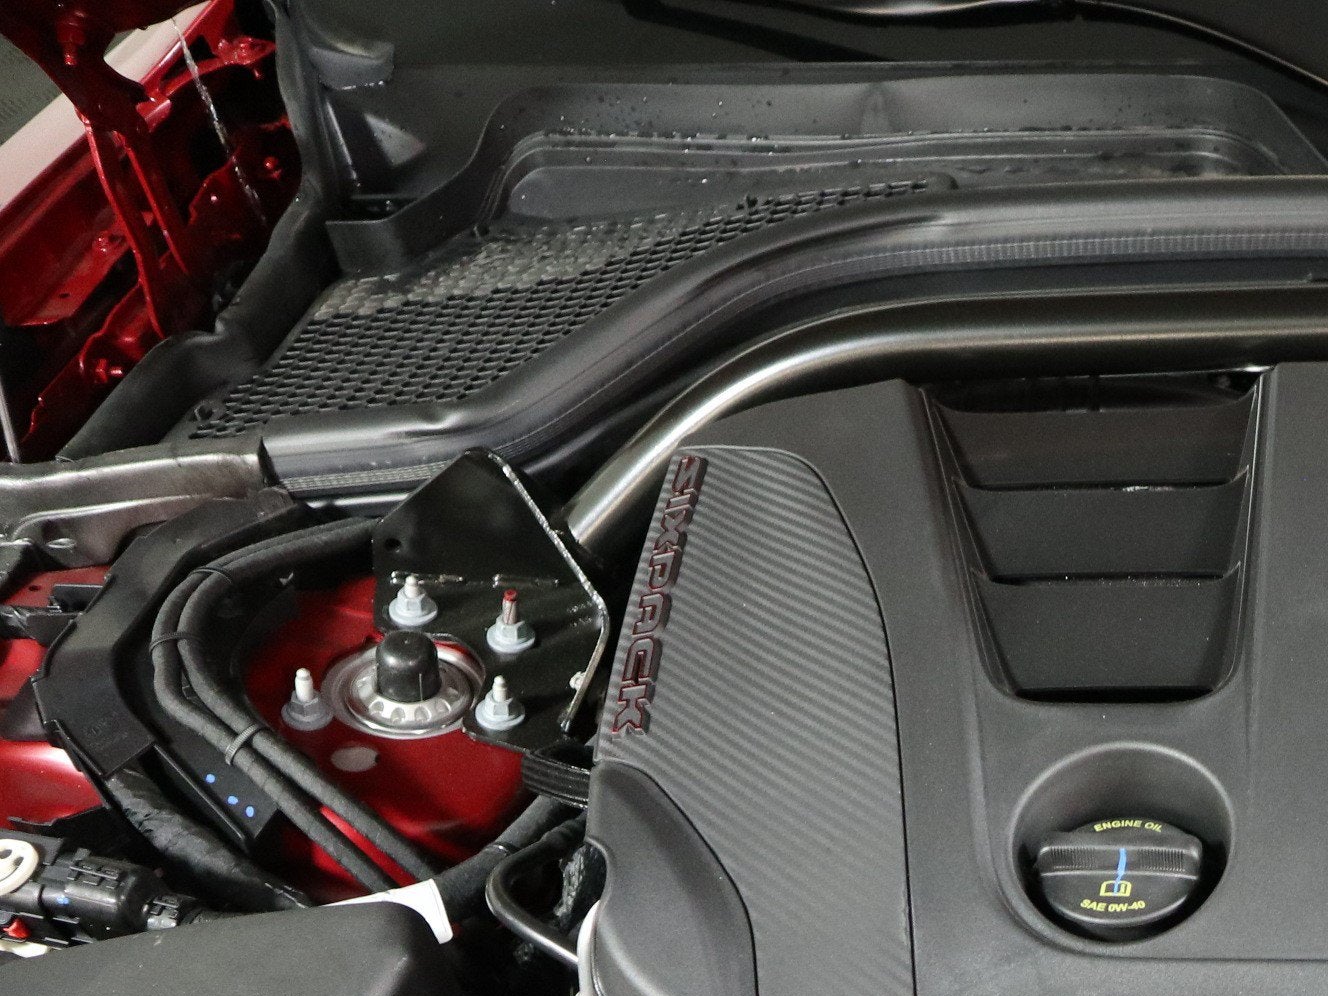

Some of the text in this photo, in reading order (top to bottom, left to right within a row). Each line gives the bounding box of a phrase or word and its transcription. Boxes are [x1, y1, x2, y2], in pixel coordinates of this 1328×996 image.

[611, 454, 706, 735] SIXPACK
[1093, 819, 1163, 833] ENGINE OIL
[1080, 898, 1147, 912] SAE 0W-40
